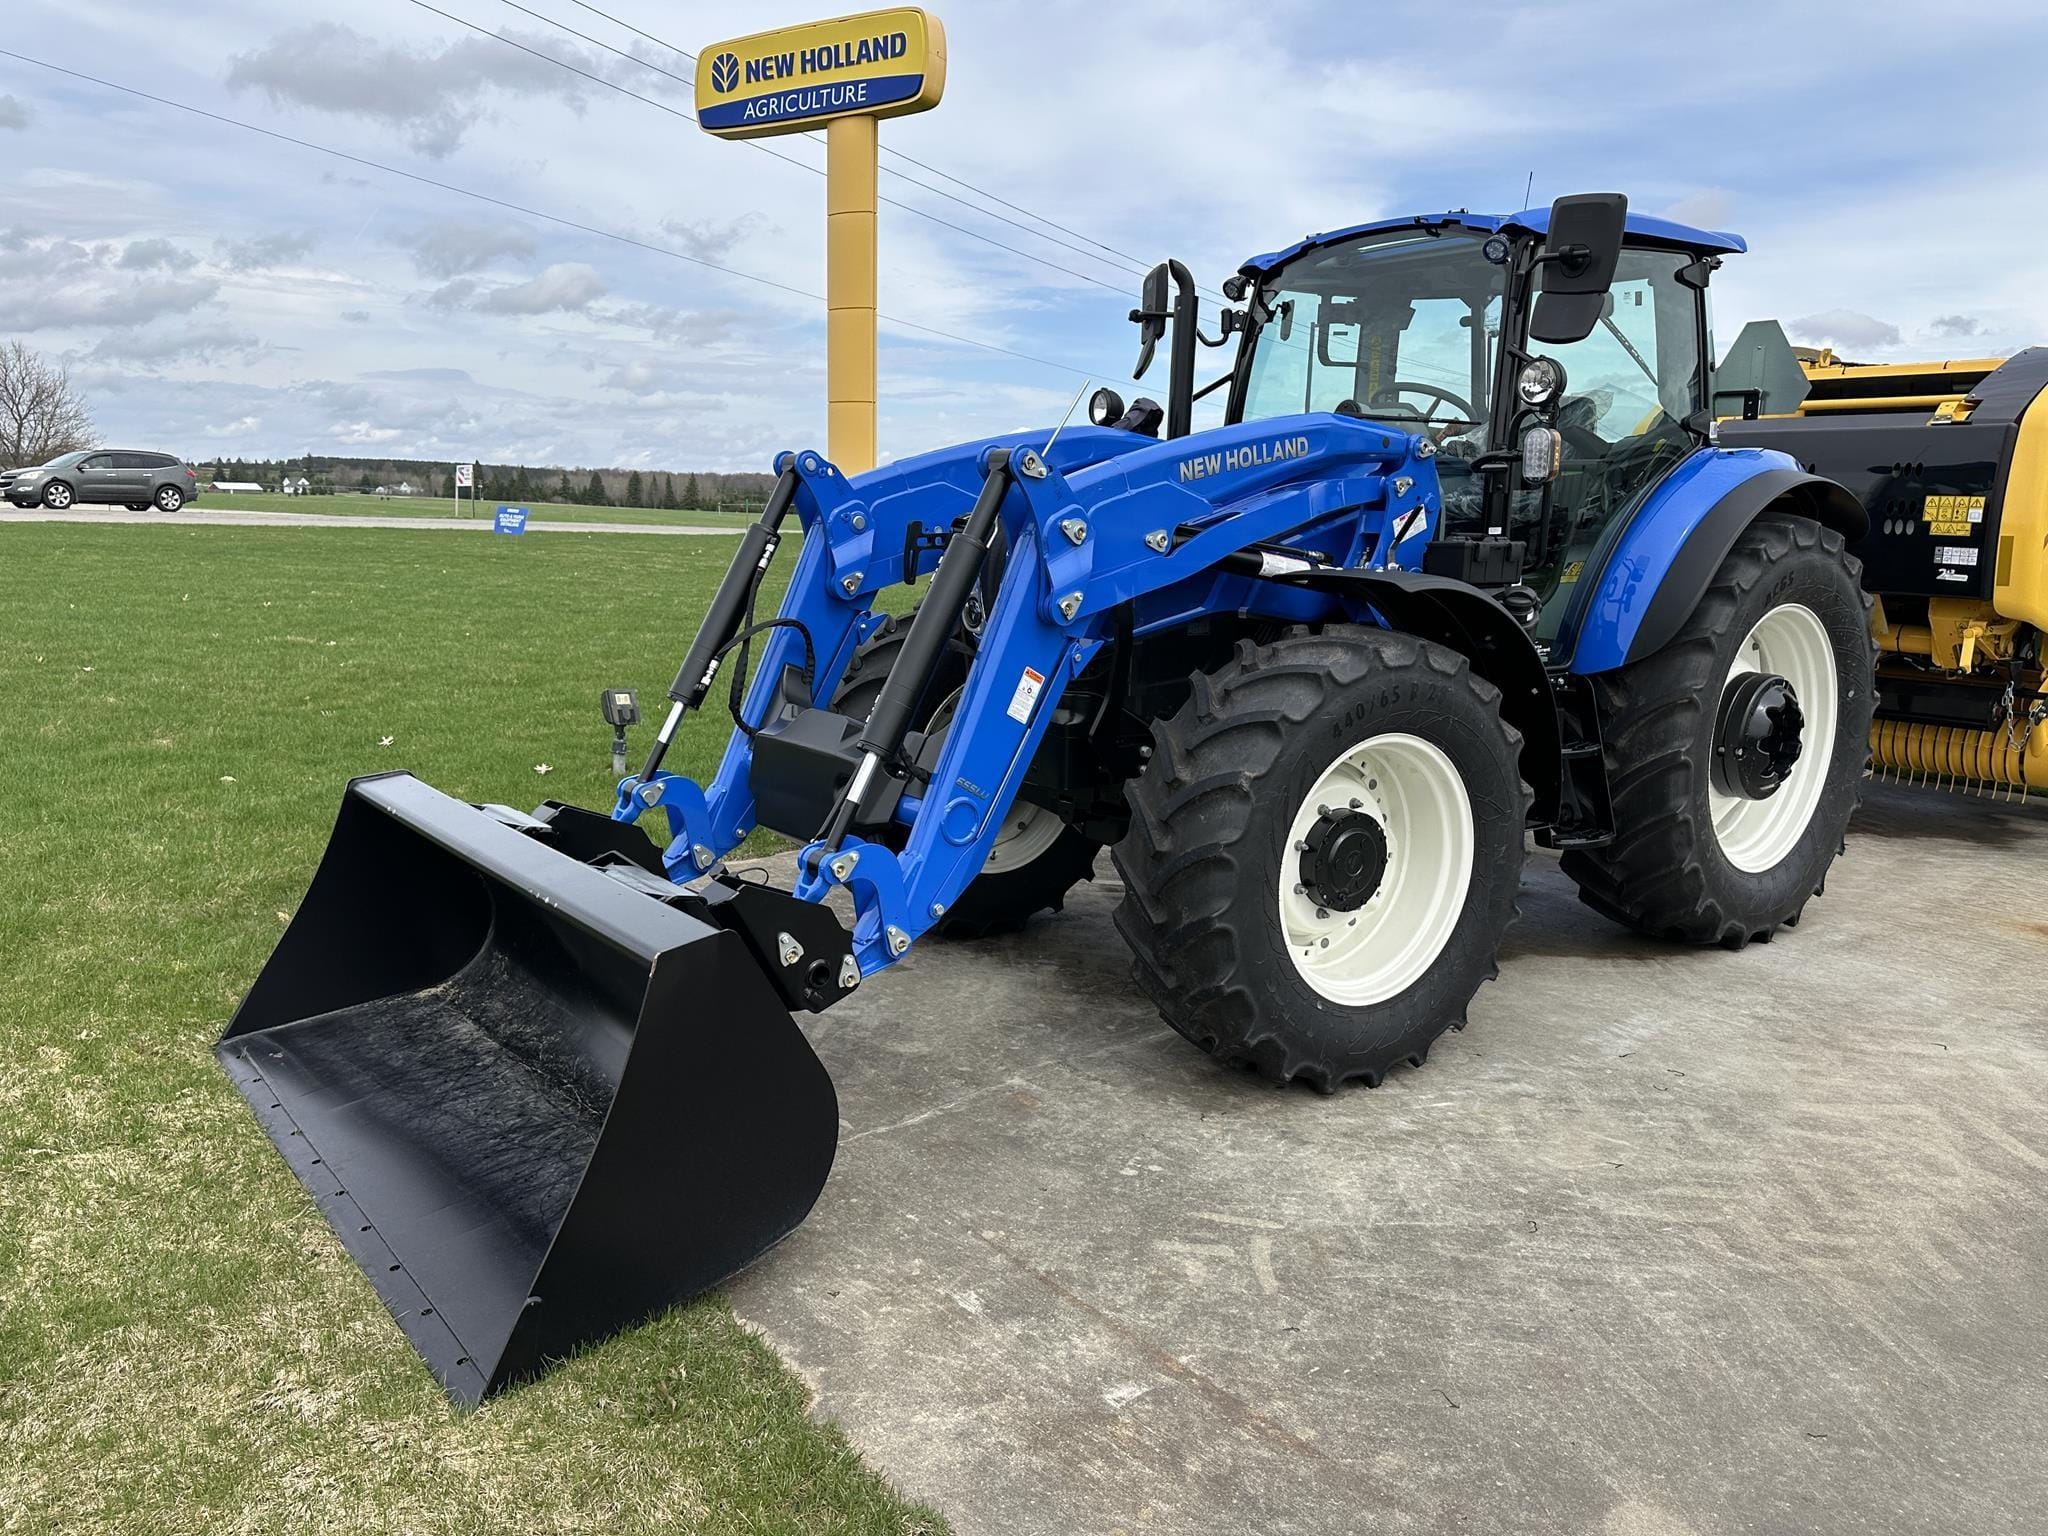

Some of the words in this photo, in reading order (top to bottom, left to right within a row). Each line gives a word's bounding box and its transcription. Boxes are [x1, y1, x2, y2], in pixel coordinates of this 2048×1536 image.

[745, 52, 795, 84] NEW
[800, 32, 907, 74] HOLLAND
[743, 83, 867, 120] AGRICULTURE
[1179, 452, 1222, 483] NEW
[1225, 436, 1309, 472] HOLLAND
